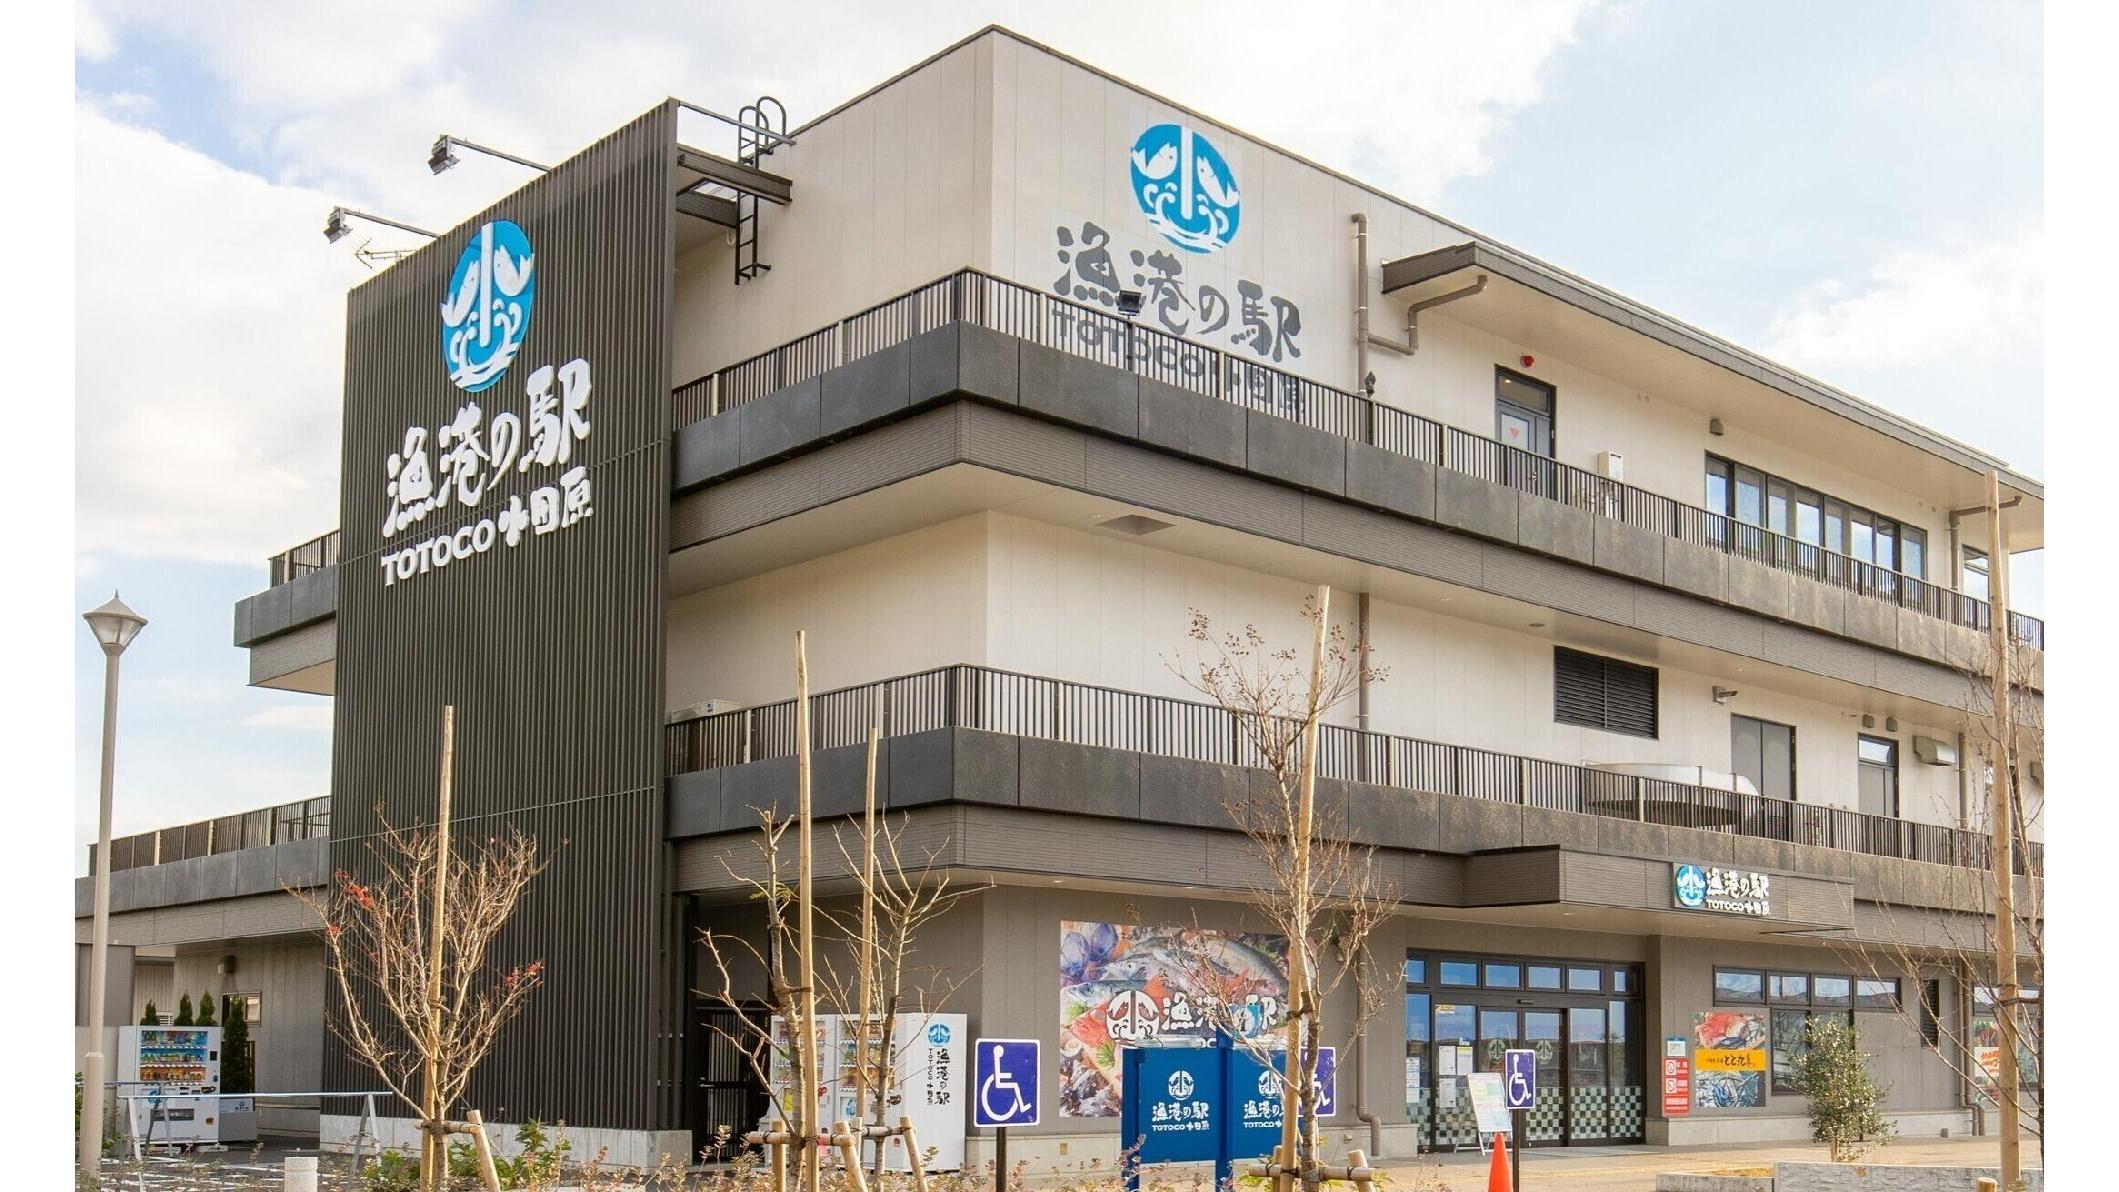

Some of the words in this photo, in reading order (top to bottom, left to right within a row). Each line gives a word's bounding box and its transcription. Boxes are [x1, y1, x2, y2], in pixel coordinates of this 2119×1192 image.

[1053, 221, 1301, 363] 漁港の駅
[382, 358, 592, 538] 漁港の駅
[1706, 867, 1770, 899] 漁港の駅
[936, 1048, 950, 1105] 漁港の駅
[1152, 1101, 1209, 1122] 漁港の駅
[1244, 1100, 1284, 1119] 漁港の
